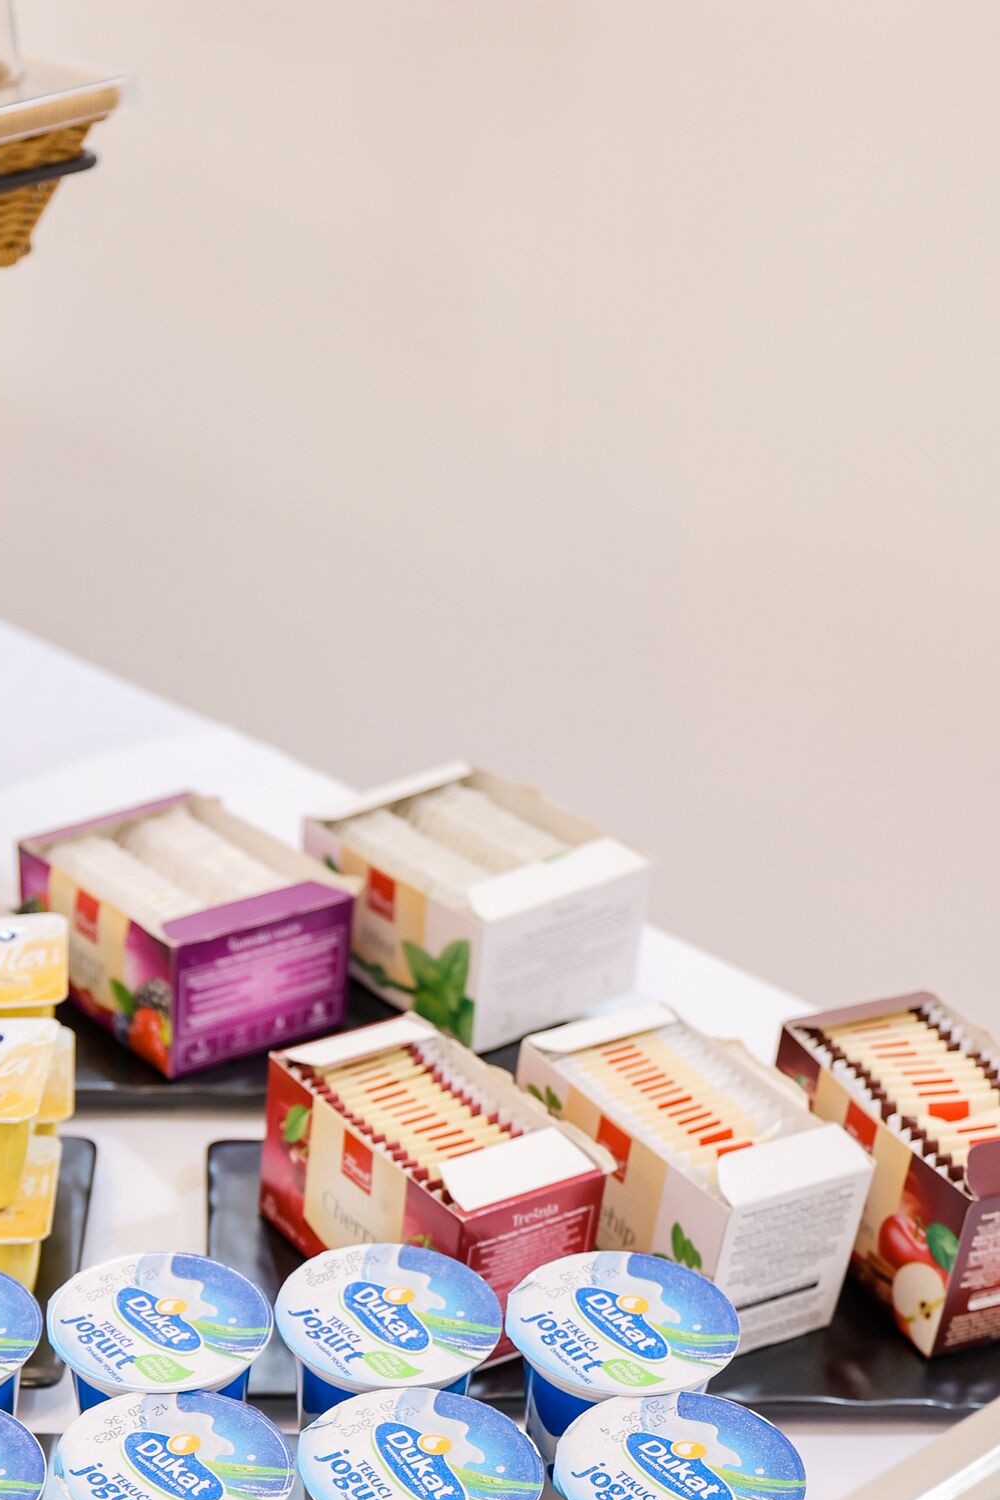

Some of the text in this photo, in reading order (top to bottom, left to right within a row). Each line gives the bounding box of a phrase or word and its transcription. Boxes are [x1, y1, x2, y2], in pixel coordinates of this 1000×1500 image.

[60, 1313, 136, 1370] jogurt
[100, 1320, 134, 1348] TEKUĆI
[126, 1295, 191, 1345] Dukat
[288, 1308, 365, 1364] jogurt
[327, 1315, 362, 1344] TEKUĆI
[352, 1286, 419, 1343] Dukat
[520, 1311, 604, 1373] jogurt
[562, 1317, 600, 1352] TEKUĆI
[585, 1293, 657, 1351] Dukat
[135, 1438, 212, 1496] Dukat
[356, 1460, 393, 1499] TEKUĆI
[385, 1430, 456, 1500] Dukat
[638, 1439, 721, 1499] Dukat
